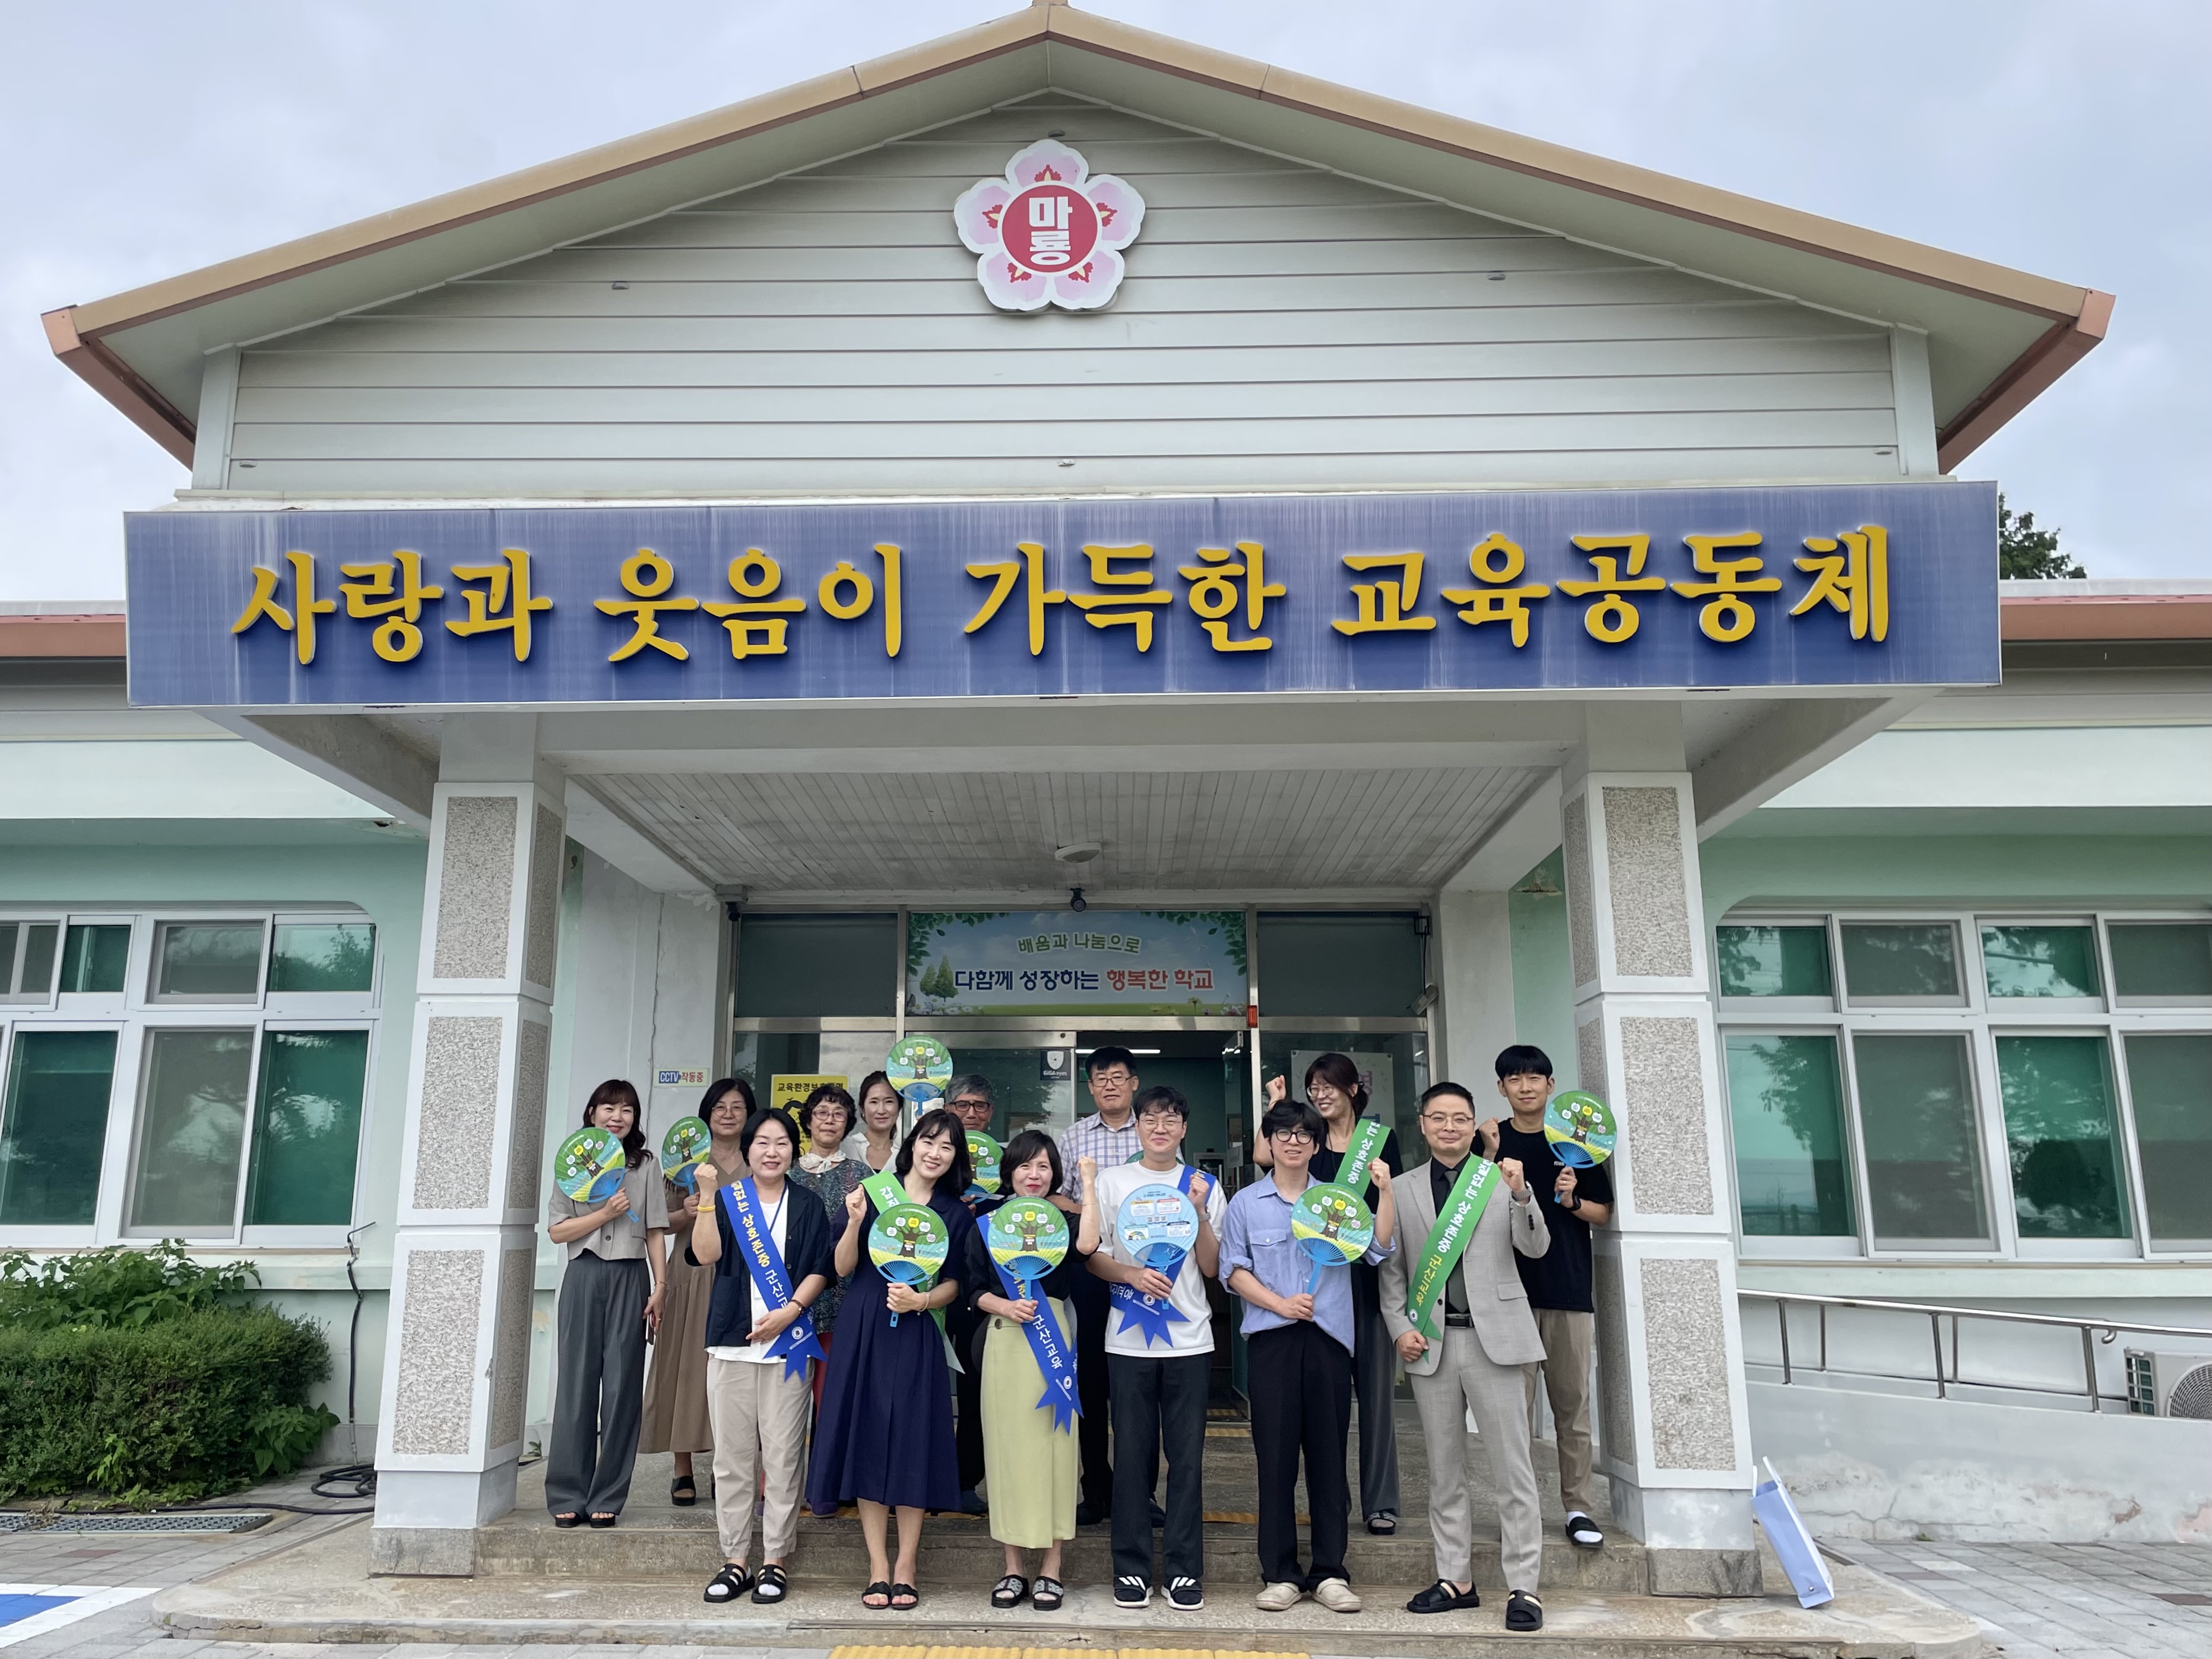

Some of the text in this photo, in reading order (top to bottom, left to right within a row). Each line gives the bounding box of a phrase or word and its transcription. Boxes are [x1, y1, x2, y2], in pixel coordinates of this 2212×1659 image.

[1029, 196, 1073, 265] 마룡
[231, 525, 1888, 665] 사랑과 웃음이 가득한 교육공동체
[1017, 932, 1141, 954] 배움과 나눔으로
[955, 969, 1215, 991] 다함께 성장하는 행복한 학교
[660, 1072, 703, 1083] CCTV 작동중
[777, 1082, 844, 1092] 교육환경보역
[1347, 1138, 1374, 1184] 상호존중
[742, 1213, 771, 1268] 상호존중
[1437, 1200, 1472, 1253] 상호존중
[1415, 1254, 1443, 1307] 군산교육
[1032, 1314, 1063, 1369] 군산교육
